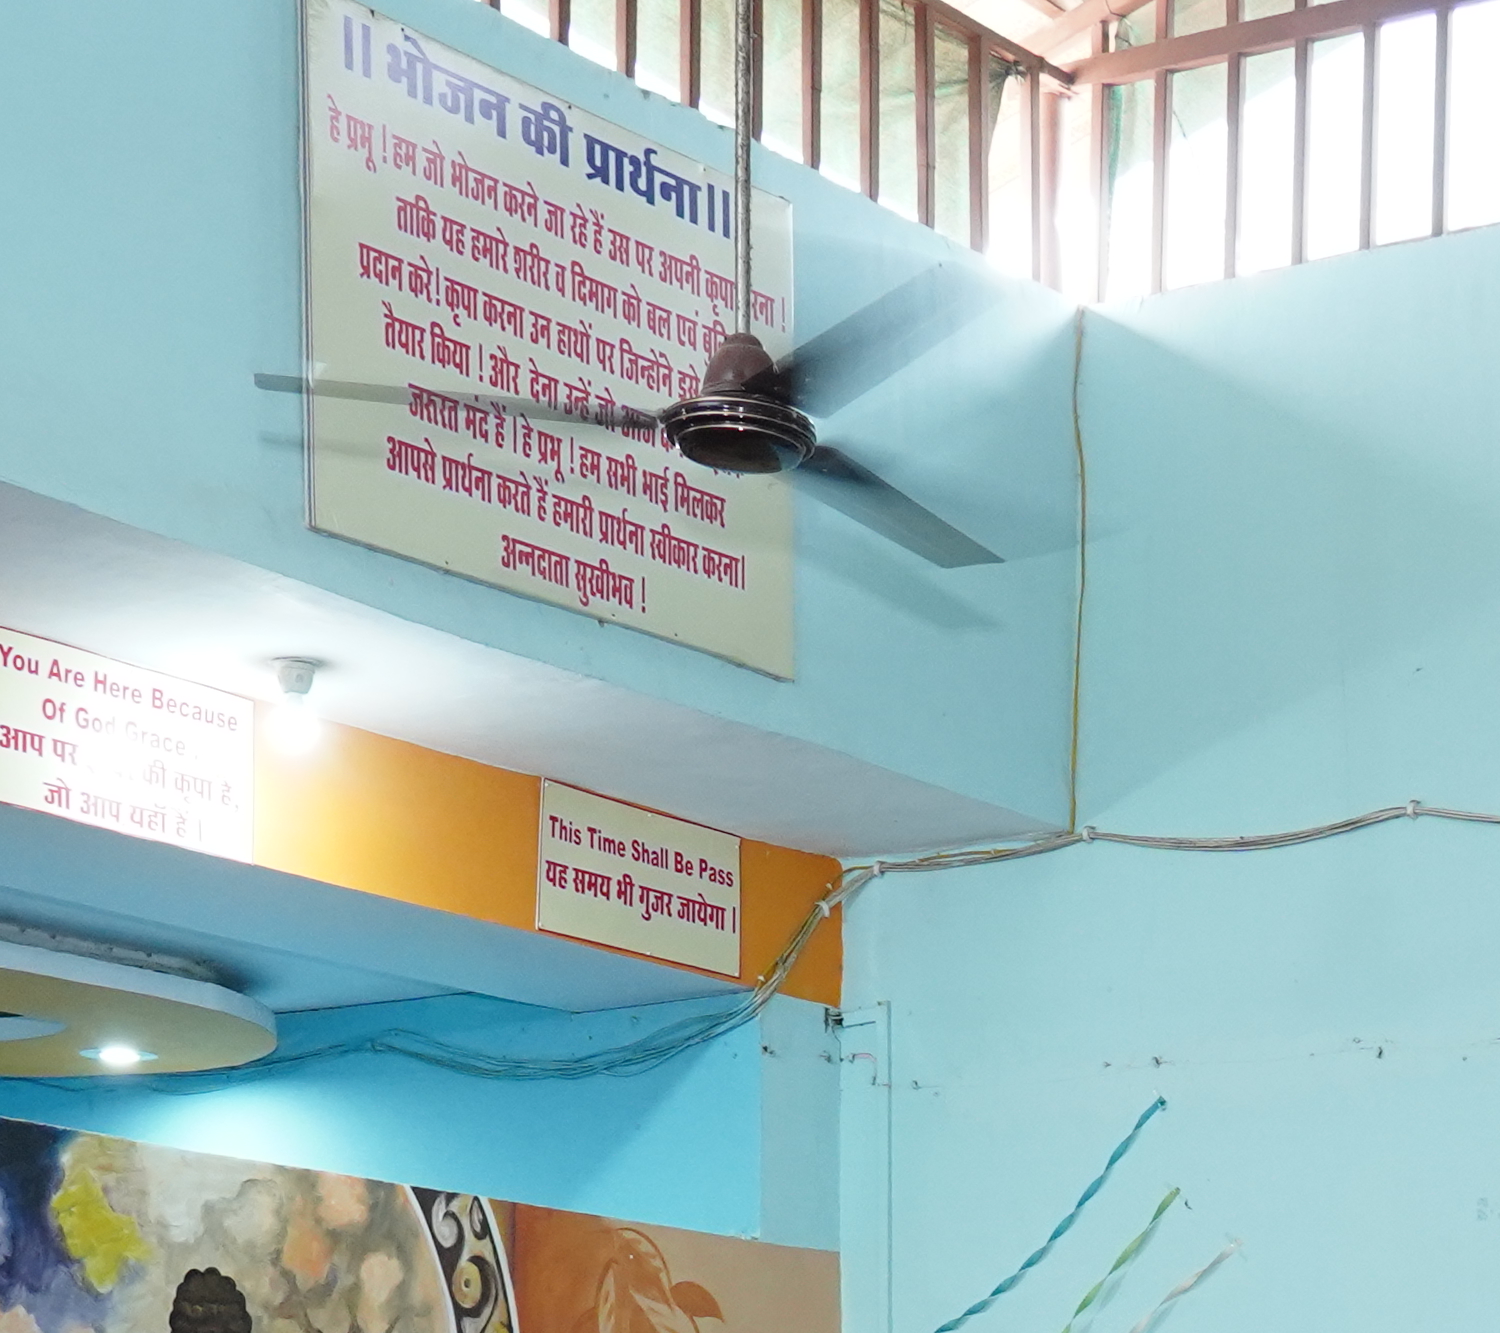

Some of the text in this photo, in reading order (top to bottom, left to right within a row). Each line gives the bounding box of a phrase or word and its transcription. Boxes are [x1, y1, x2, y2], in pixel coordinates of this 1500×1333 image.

[386, 34, 511, 139] भोजन
[518, 101, 573, 168] की
[385, 436, 437, 485] आपसे
[441, 453, 493, 504] प्रार्थना
[496, 471, 532, 517] करते
[533, 475, 549, 522] हैं
[552, 494, 594, 538] हमारी
[598, 508, 646, 557] प्रार्थना
[649, 523, 700, 575] स्वीकार
[501, 534, 570, 588] अन्नदाता
[41, 698, 66, 723] Of
[75, 707, 115, 735] God
[47, 659, 85, 688] Are
[93, 670, 143, 704] Here
[151, 687, 238, 731] Because
[51, 738, 79, 765] पर
[43, 777, 71, 809] जो
[80, 791, 121, 823] आप
[549, 815, 734, 887] This Time Shall Be Pass
[545, 860, 726, 931] यह समय भी गुजर जायेगा
